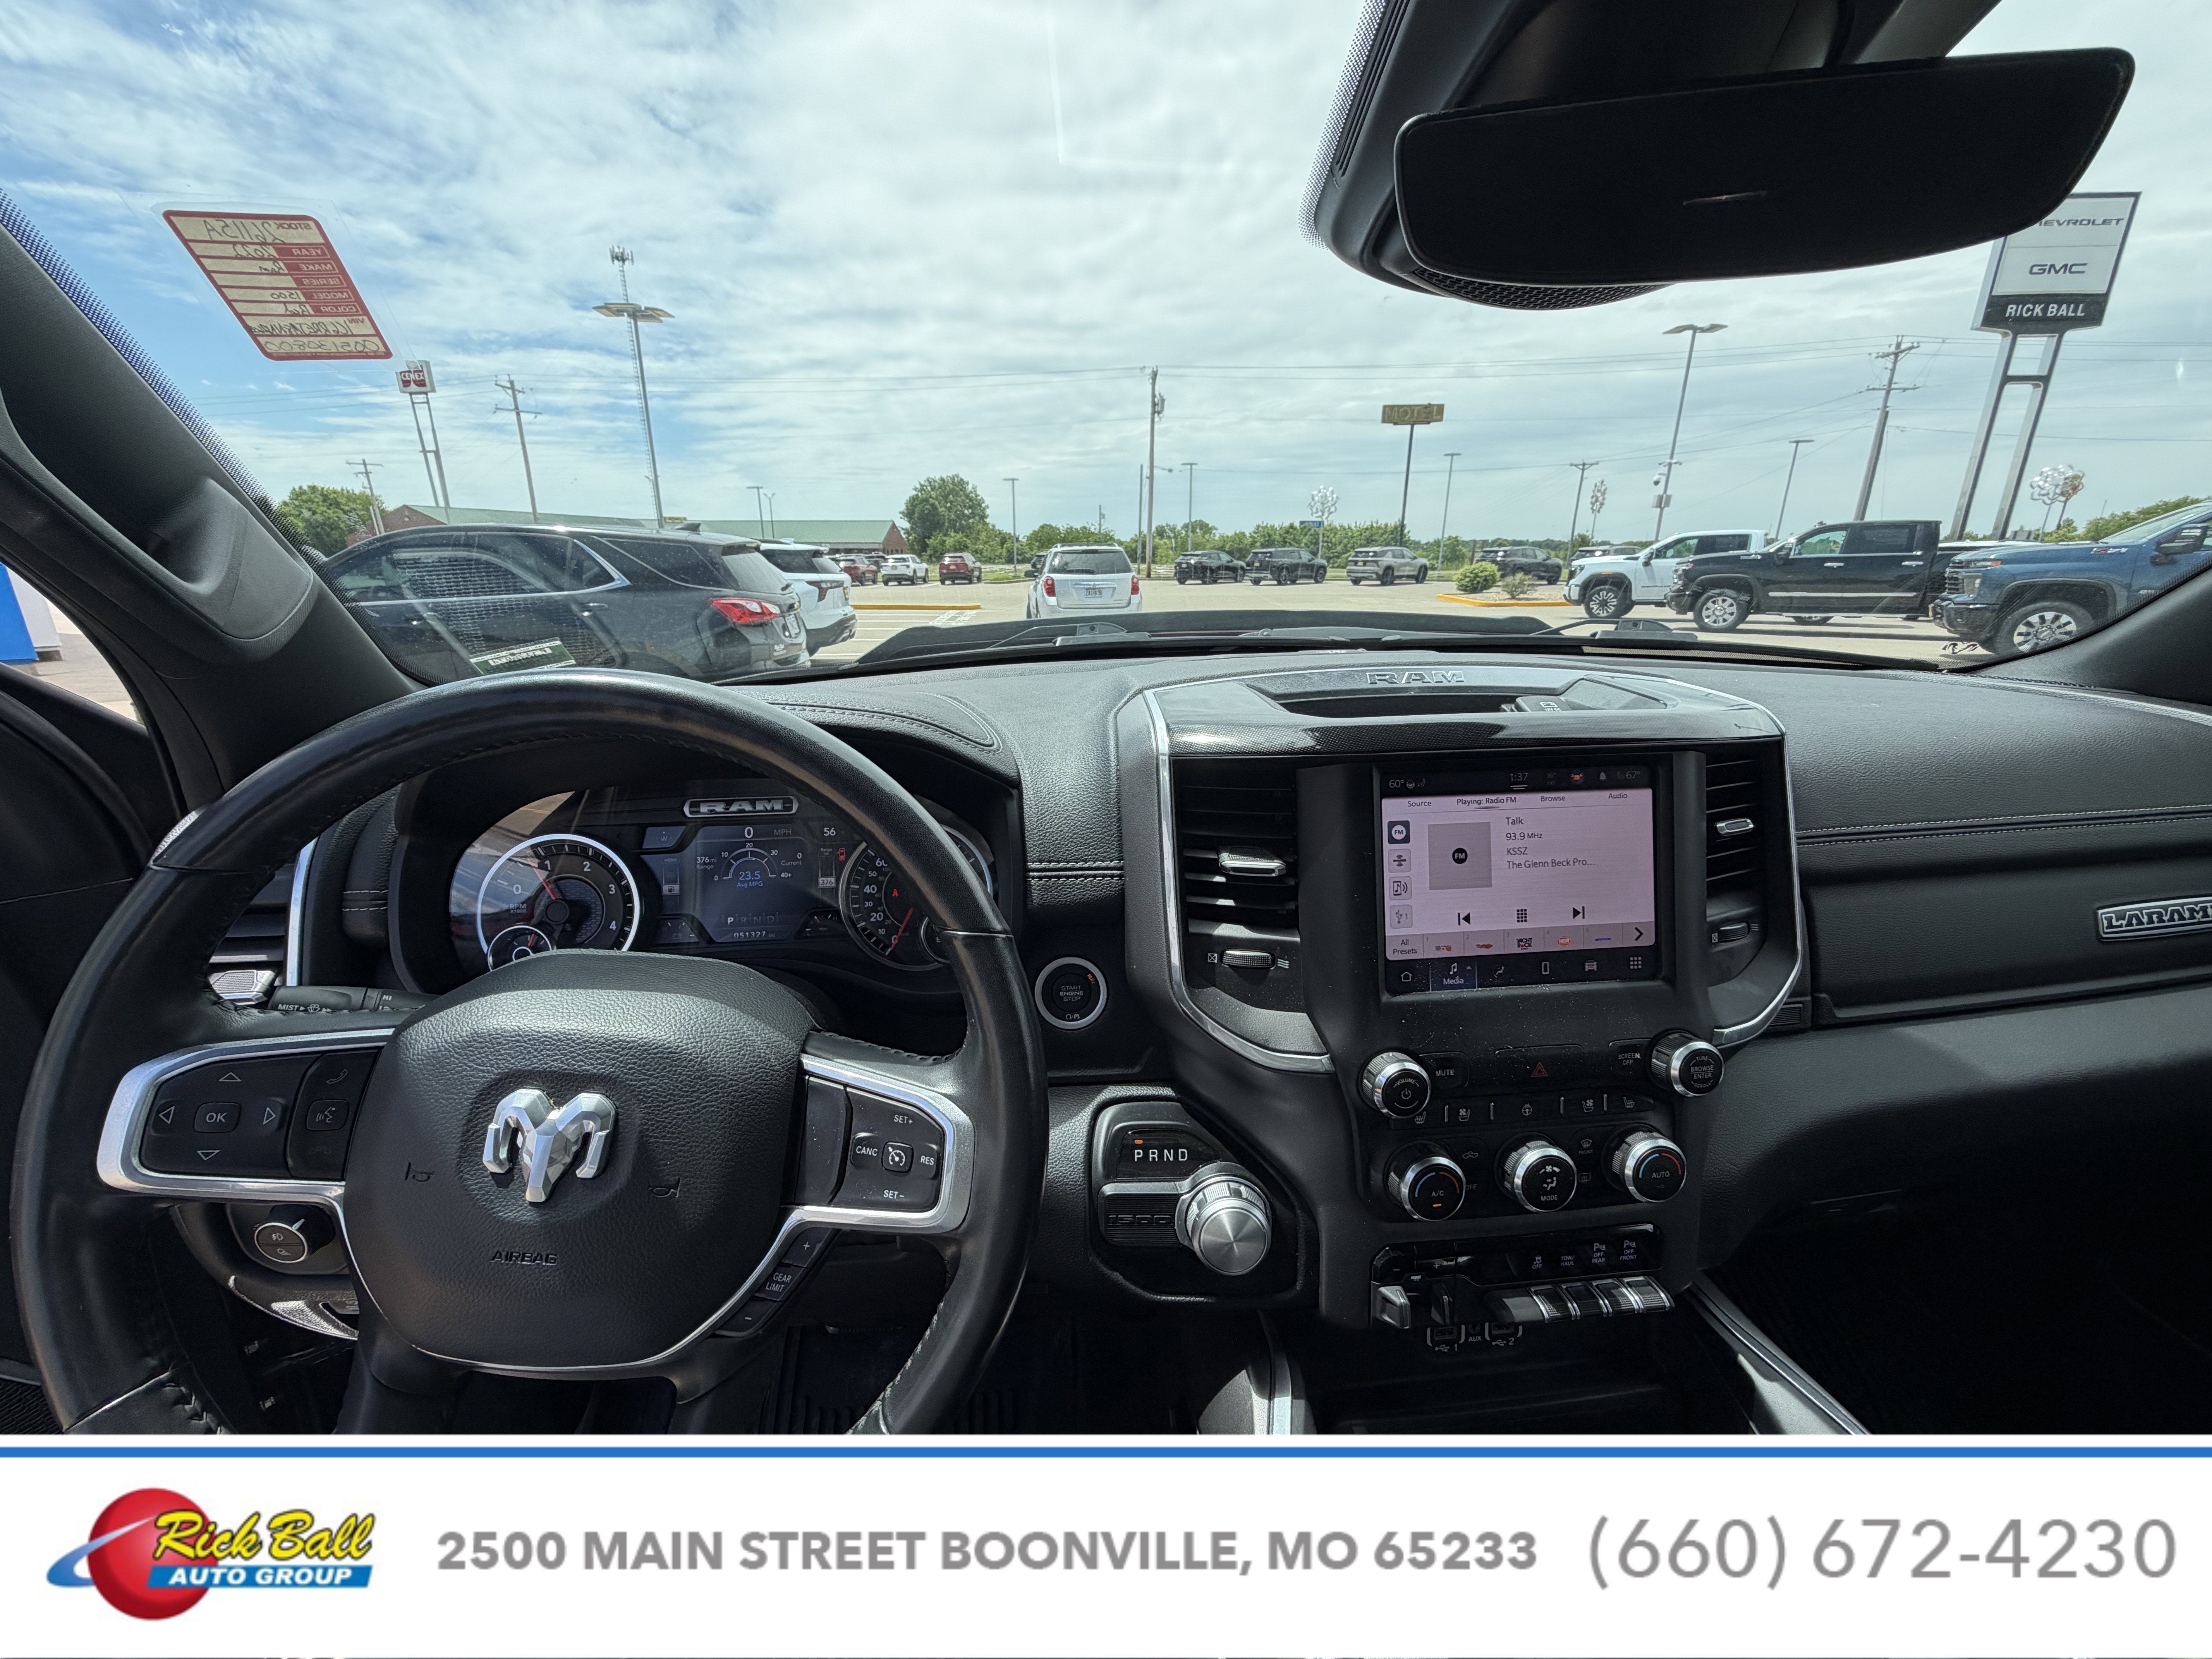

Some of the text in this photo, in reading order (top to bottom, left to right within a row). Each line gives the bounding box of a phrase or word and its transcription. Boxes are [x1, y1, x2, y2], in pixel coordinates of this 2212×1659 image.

[2028, 263, 2088, 275] GMC
[2006, 303, 2085, 317] RICK BALL
[401, 371, 425, 381] CENEX
[1366, 670, 1464, 684] RAM
[1510, 773, 1528, 781] 1:37
[700, 799, 783, 813] RAM
[1506, 817, 1524, 825] Talk
[744, 826, 754, 838] 0
[824, 828, 836, 836] 56
[1506, 833, 1525, 841] 93.9
[1507, 847, 1528, 855] KSSZ
[544, 860, 551, 871] 1
[583, 861, 591, 872] 2
[1506, 857, 1595, 869] The Glenn Beck Pro...
[739, 871, 761, 881] 23.5
[513, 884, 522, 894] 0
[609, 884, 615, 894] 3
[864, 885, 877, 894] 40
[870, 912, 884, 921] 20
[2102, 903, 2212, 932] LARAM
[609, 920, 617, 930] 4
[1443, 976, 1464, 985] Media
[277, 1003, 299, 1012] MIST
[206, 1112, 226, 1123] OK
[855, 1146, 878, 1157] CANC
[920, 1155, 934, 1166] RES
[491, 1251, 558, 1266] AIRBAG
[773, 1272, 792, 1283] GEAR
[765, 1282, 785, 1293] LIMIT
[1508, 1337, 1515, 1345] 2
